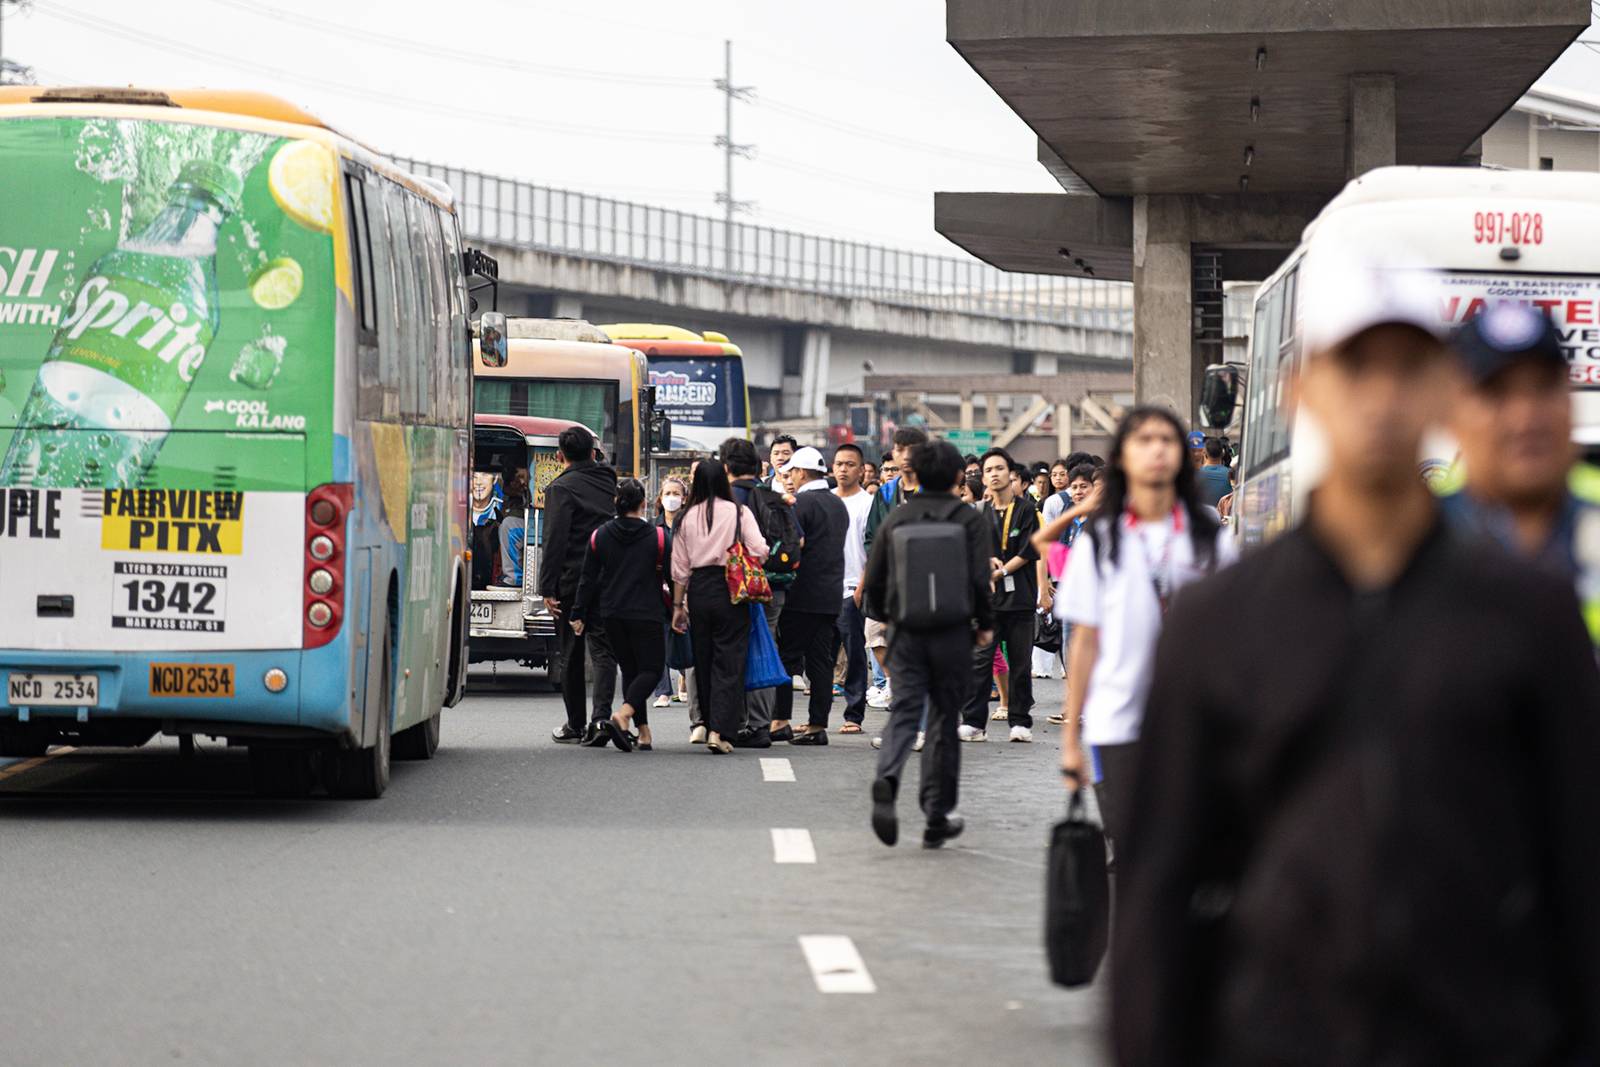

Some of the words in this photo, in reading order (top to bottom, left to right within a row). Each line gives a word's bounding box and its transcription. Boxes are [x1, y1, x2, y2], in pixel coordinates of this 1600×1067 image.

[1474, 212, 1543, 245] 997-028
[1487, 288, 1578, 296] COOPERATIVE
[1515, 280, 1592, 290] TRANSPORT
[0, 303, 62, 326] WITH
[62, 276, 205, 383] Sprite
[226, 400, 269, 414] COOL
[236, 414, 260, 428] KA
[261, 415, 306, 430] LANG
[104, 488, 244, 521] FAIRVIEW
[129, 519, 222, 553] PITX
[123, 563, 153, 575] LTFRB
[156, 565, 180, 576] 24/7
[183, 566, 225, 577] HOTLINE
[122, 580, 217, 615] 1342
[125, 617, 150, 627] MAX
[150, 618, 177, 628] PASS
[179, 620, 203, 630] CAP:
[11, 680, 42, 698] NCD
[54, 681, 95, 699] 2534
[152, 666, 184, 693] NCD
[186, 667, 232, 693] 2534
